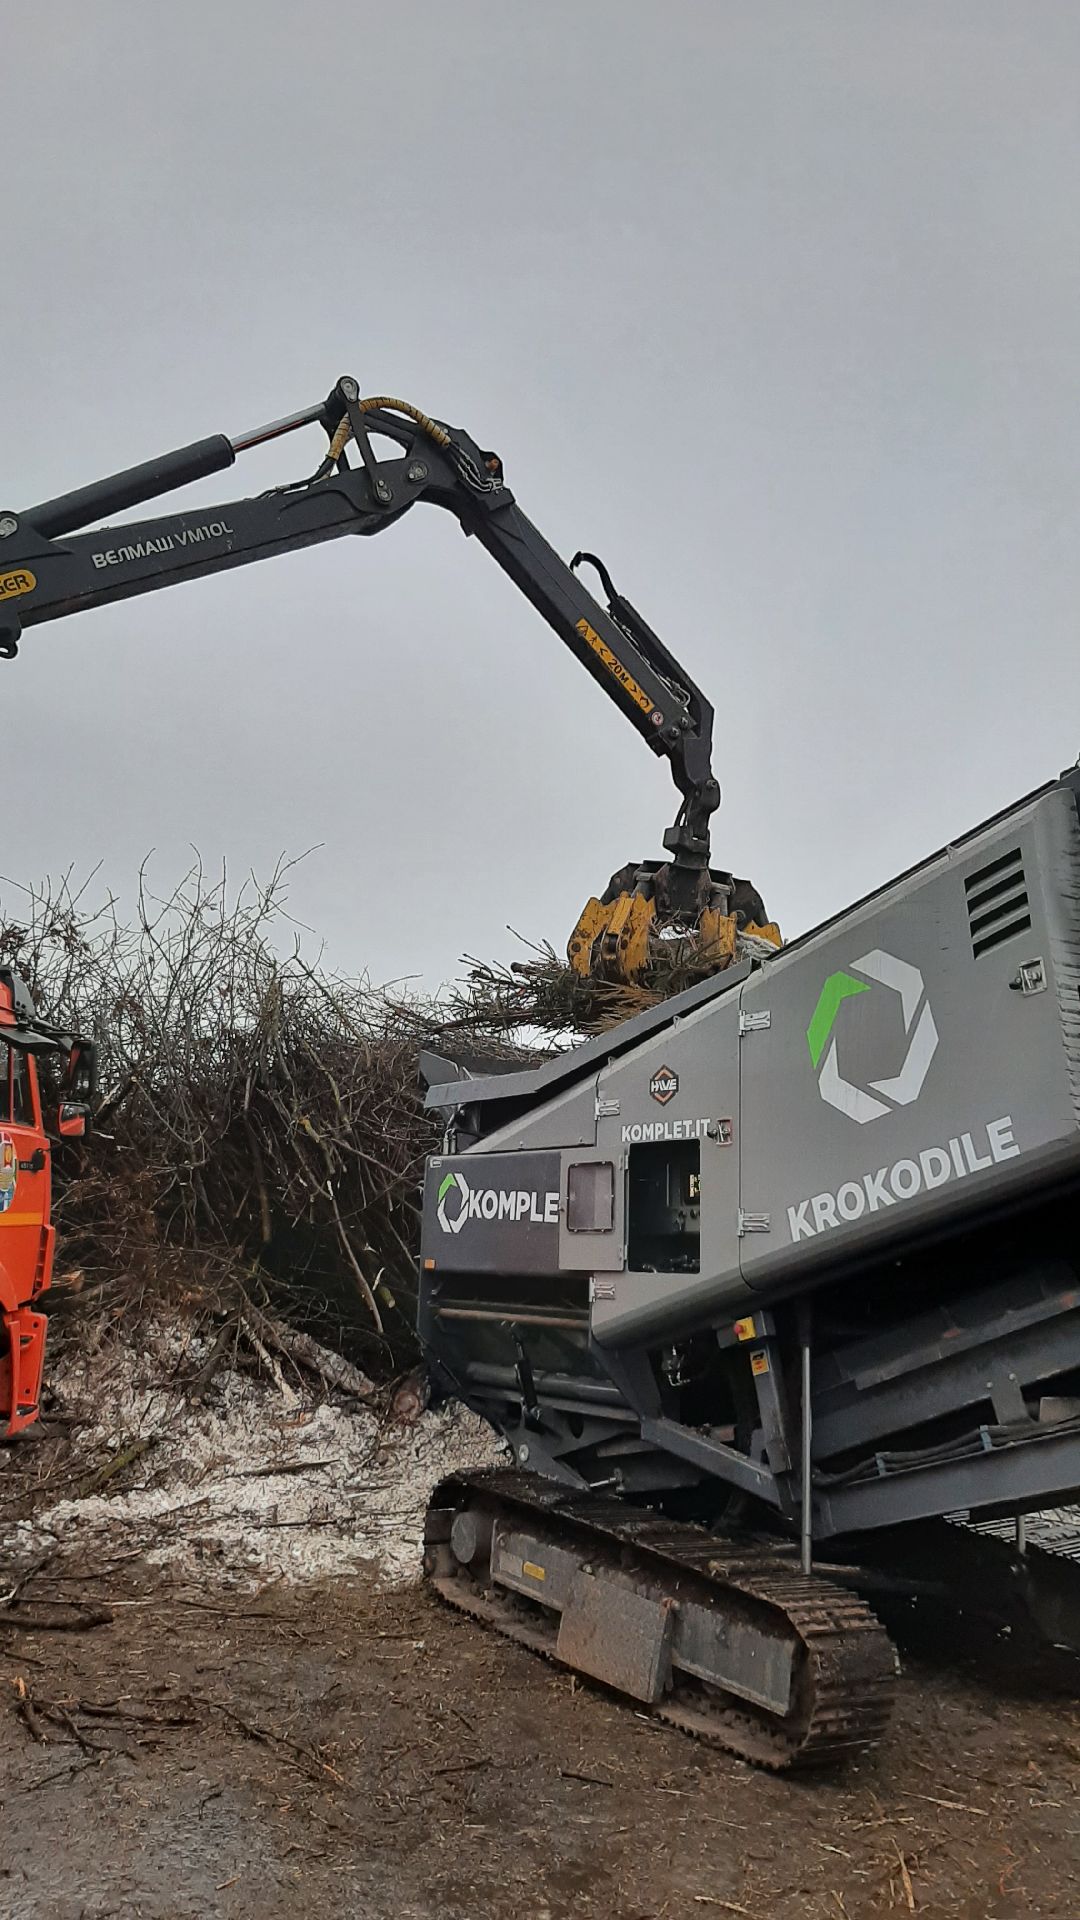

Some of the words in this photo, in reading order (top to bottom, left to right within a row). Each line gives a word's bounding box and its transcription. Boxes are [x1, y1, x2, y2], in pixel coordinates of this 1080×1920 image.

[91, 535, 175, 569] ВЕЛМАШ
[174, 521, 234, 546] VM10L
[621, 1118, 711, 1142] KOMPLET.IT
[787, 1115, 1021, 1243] KROKODILE
[468, 1189, 561, 1223] KOMPLE
